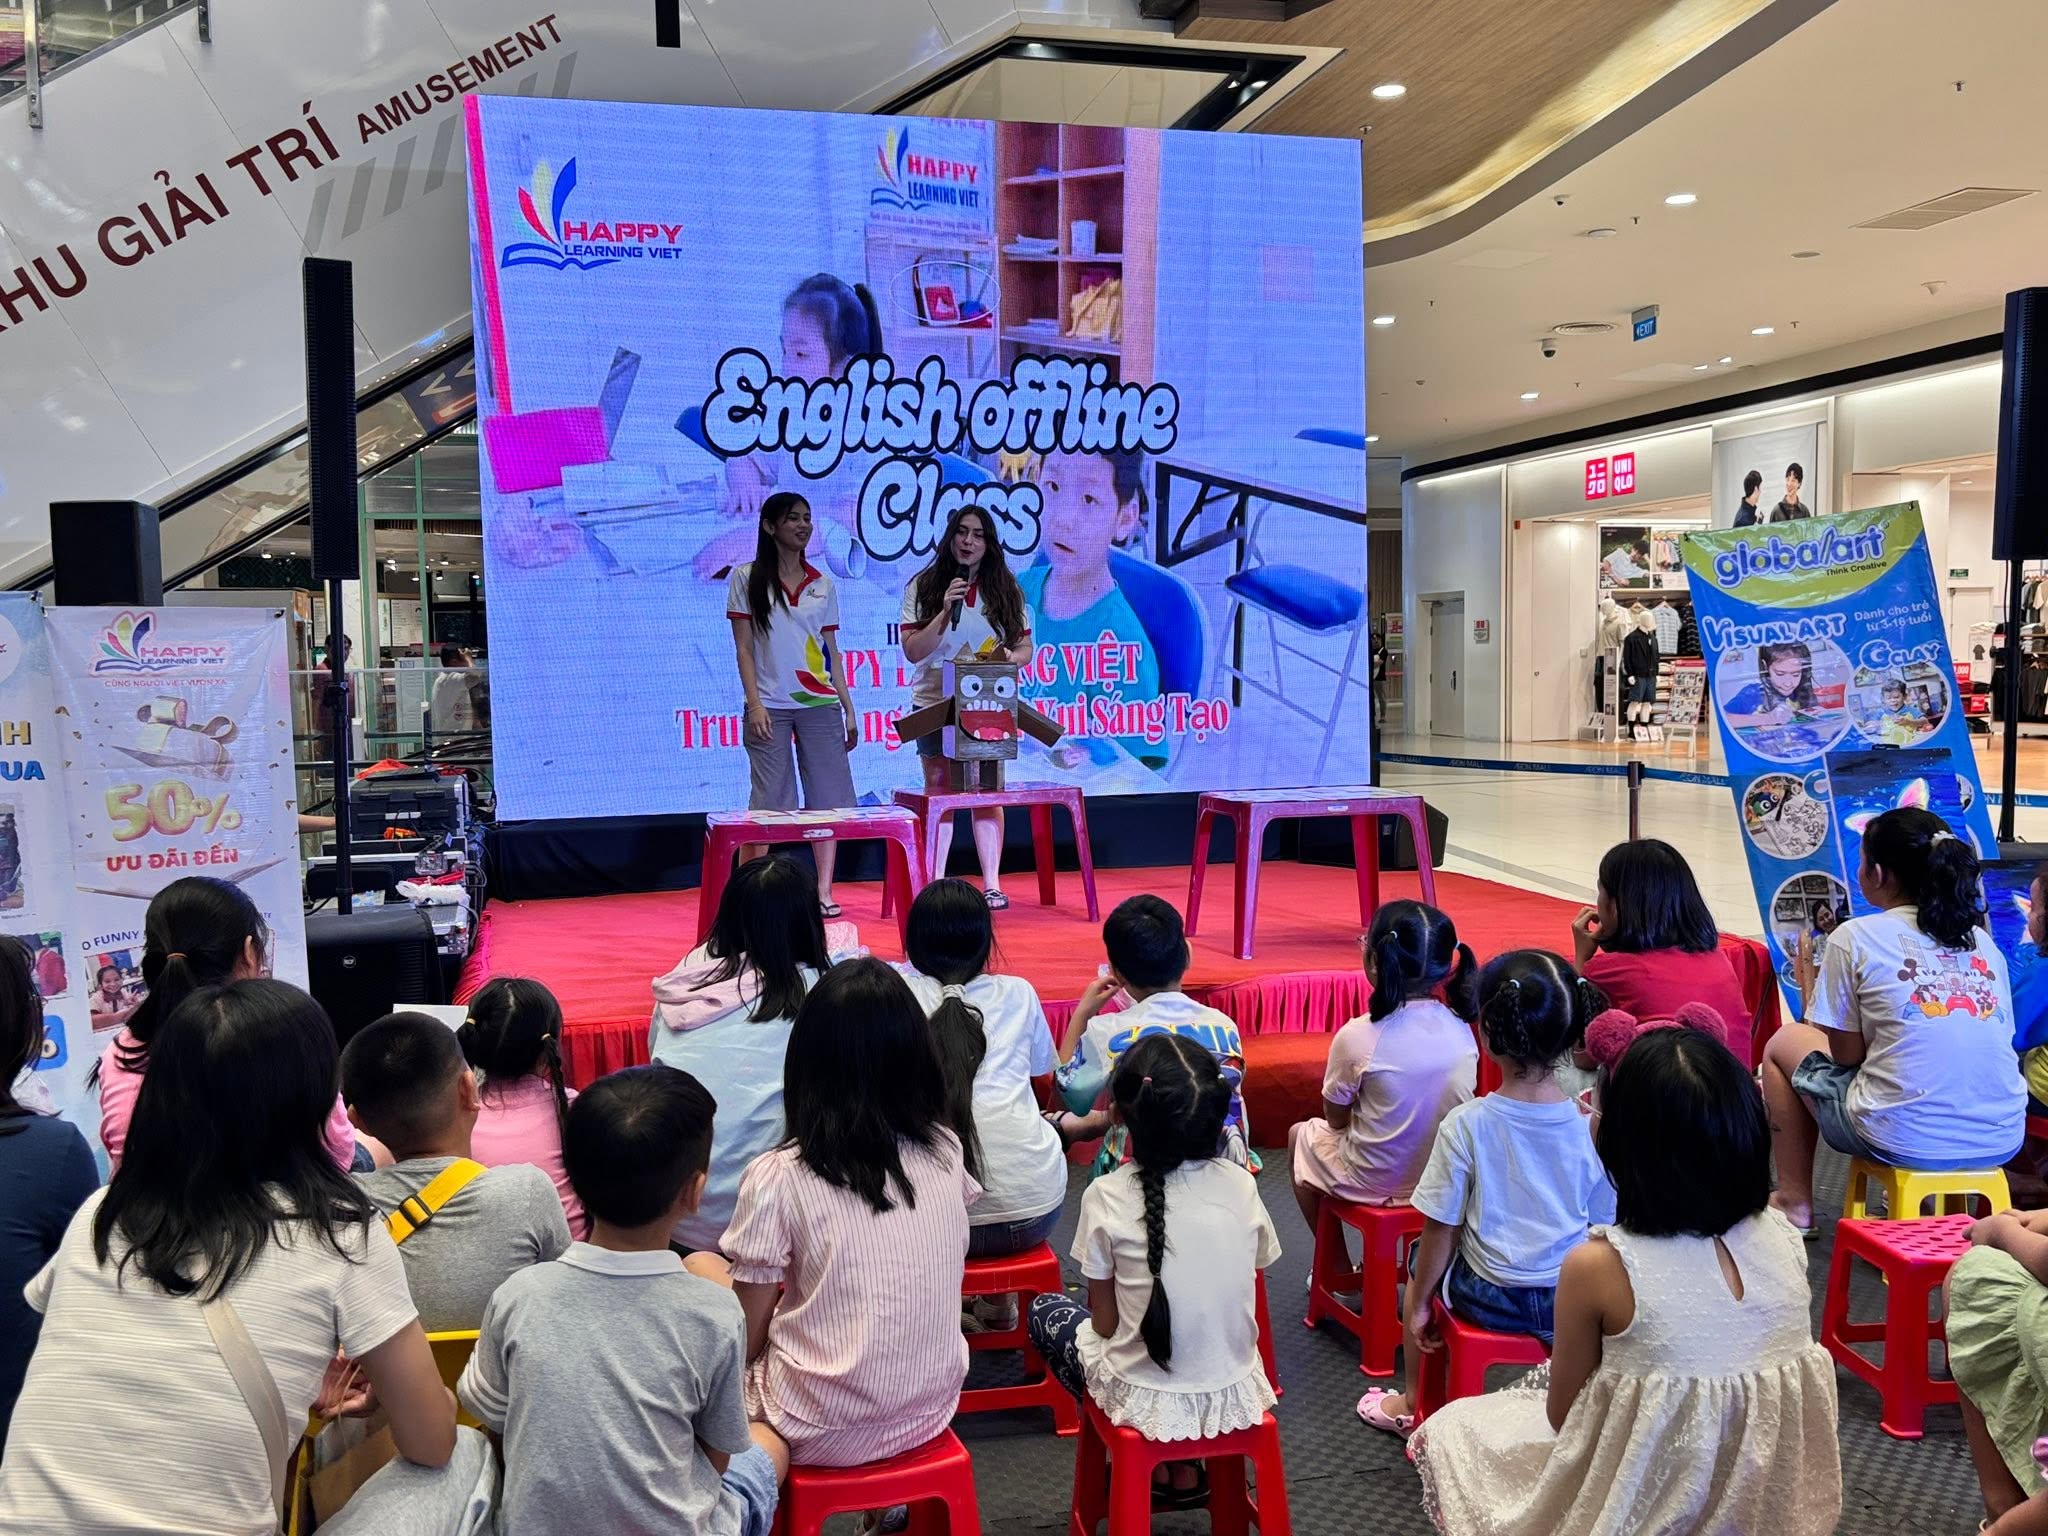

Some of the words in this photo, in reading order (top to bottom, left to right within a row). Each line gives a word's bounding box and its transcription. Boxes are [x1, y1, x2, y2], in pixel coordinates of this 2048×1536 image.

[355, 13, 564, 145] AMUSEMENT
[907, 154, 977, 184] HAPPY
[908, 181, 957, 205] LEARNING
[959, 188, 979, 208] VIET
[0, 244, 87, 333] HU
[98, 170, 229, 268] GIẢI
[227, 101, 340, 196] TRÍ
[563, 220, 684, 244] HAPPY
[564, 245, 643, 258] LEARNING
[648, 247, 683, 259] VIET
[1640, 320, 1654, 337] EXIT
[702, 347, 967, 480] English
[966, 353, 1180, 456] offline
[1826, 566, 1849, 576] Think
[1850, 561, 1887, 573] Creative
[1854, 608, 1885, 621] Dành
[1888, 605, 1909, 617] cho
[1797, 613, 1847, 642] ART
[140, 646, 226, 657] HAPPY
[1060, 631, 1141, 690] VIỆT
[1092, 690, 1165, 742] Sáng
[1168, 695, 1228, 740] Tạo
[1466, 760, 1484, 768] MALL
[105, 779, 243, 842] 50%
[107, 854, 142, 872] ƯU
[148, 847, 188, 869] ĐÃI
[193, 842, 239, 865] ĐẾN
[94, 930, 140, 947] FUNNY
